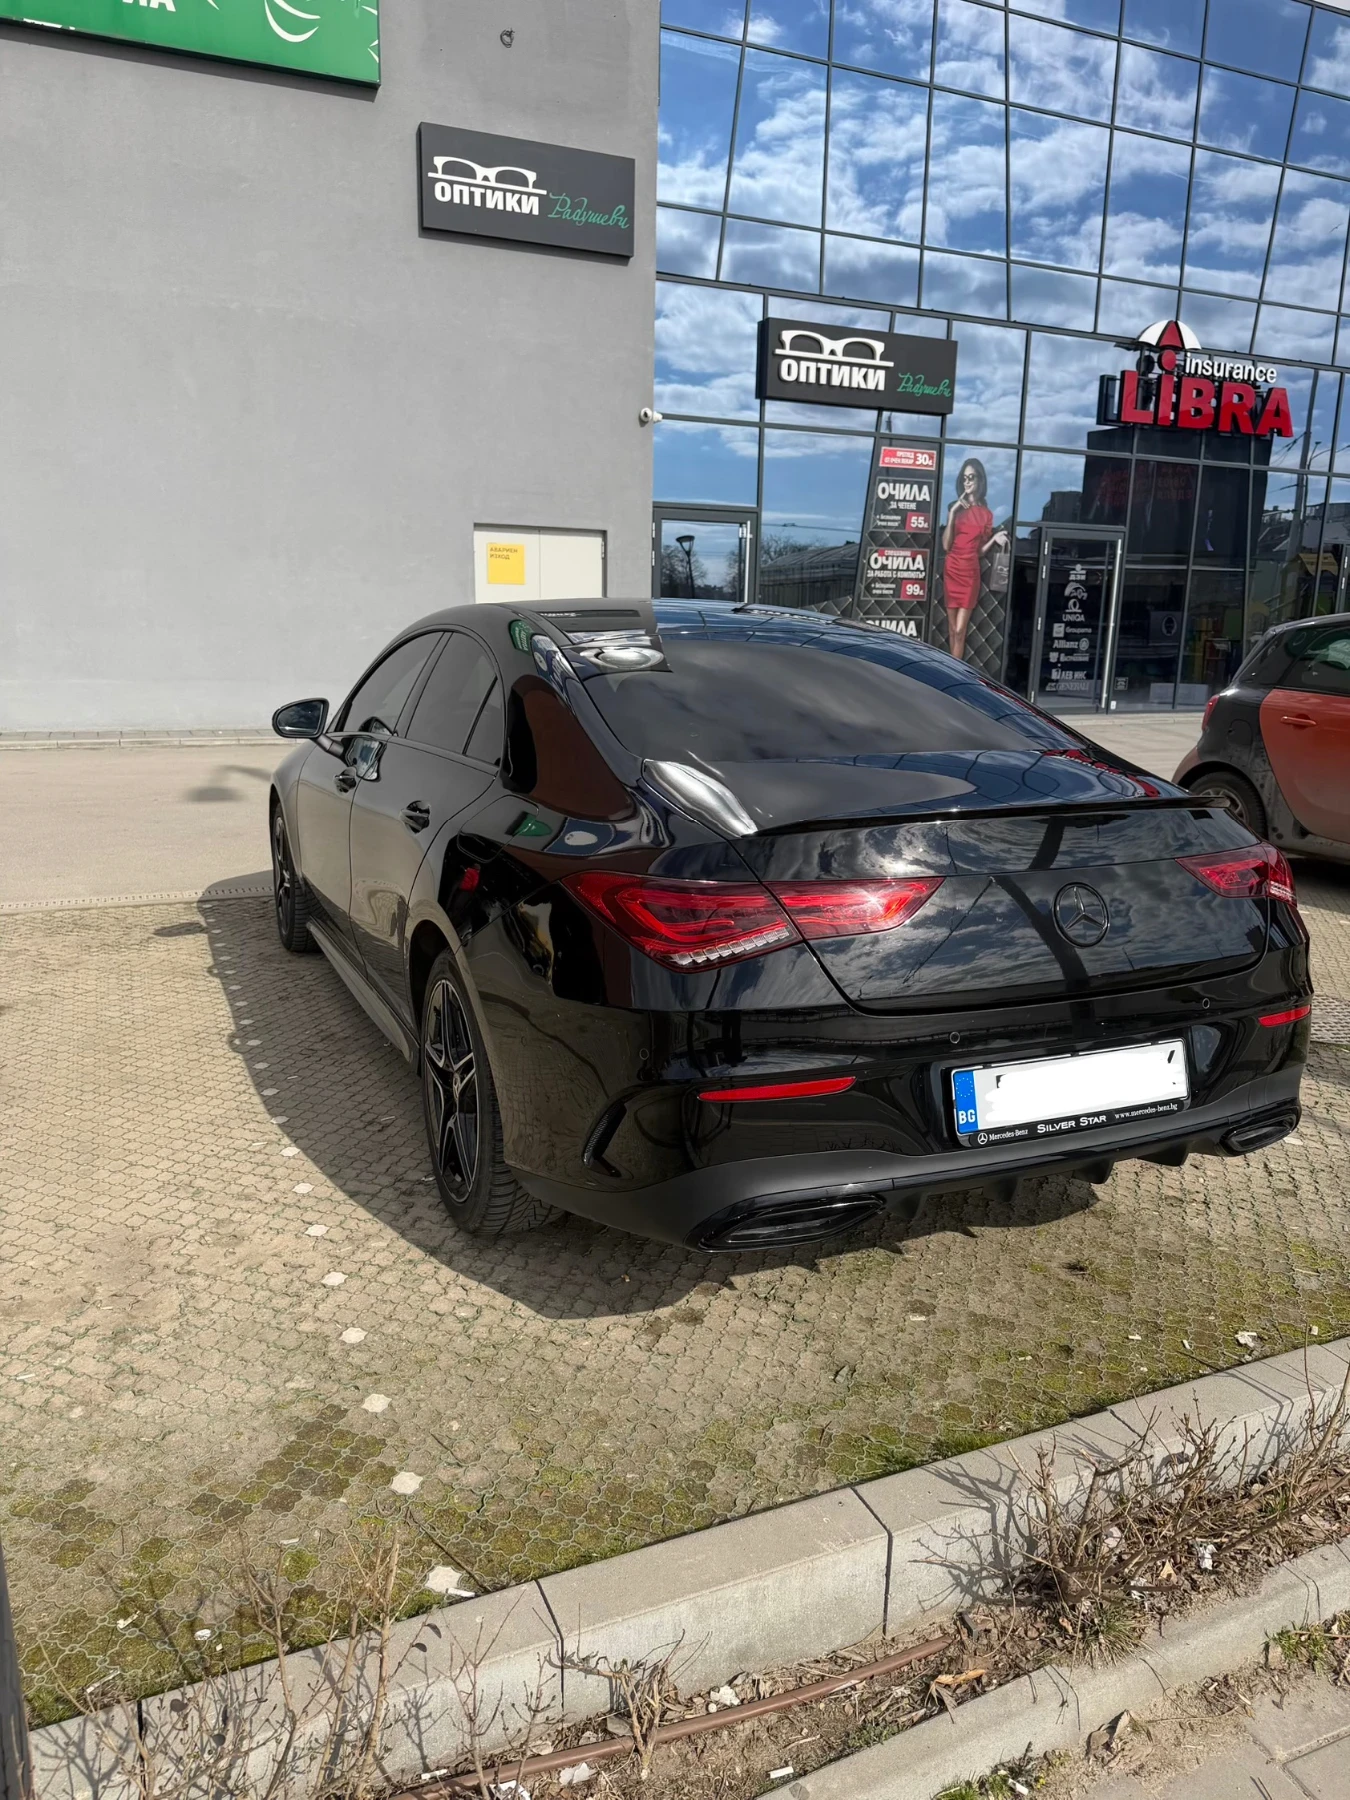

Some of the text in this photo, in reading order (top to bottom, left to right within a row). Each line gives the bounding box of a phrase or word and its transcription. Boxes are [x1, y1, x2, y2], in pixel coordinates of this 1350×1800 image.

[434, 181, 630, 229] ОПТИКИ Радушеви
[780, 358, 886, 391] ОПТИКИ
[1185, 353, 1277, 383] insurance
[877, 482, 931, 502] ОЧИЛА
[869, 552, 925, 571] ОЧИЛА
[1062, 614, 1085, 622] UNIQA
[1065, 626, 1092, 634] Groupama
[1053, 639, 1078, 649] Allianz
[958, 1109, 976, 1125] BG
[988, 1102, 1178, 1142] Mercedes-Benz SILVER STAR www.mercedes-benz.bg
